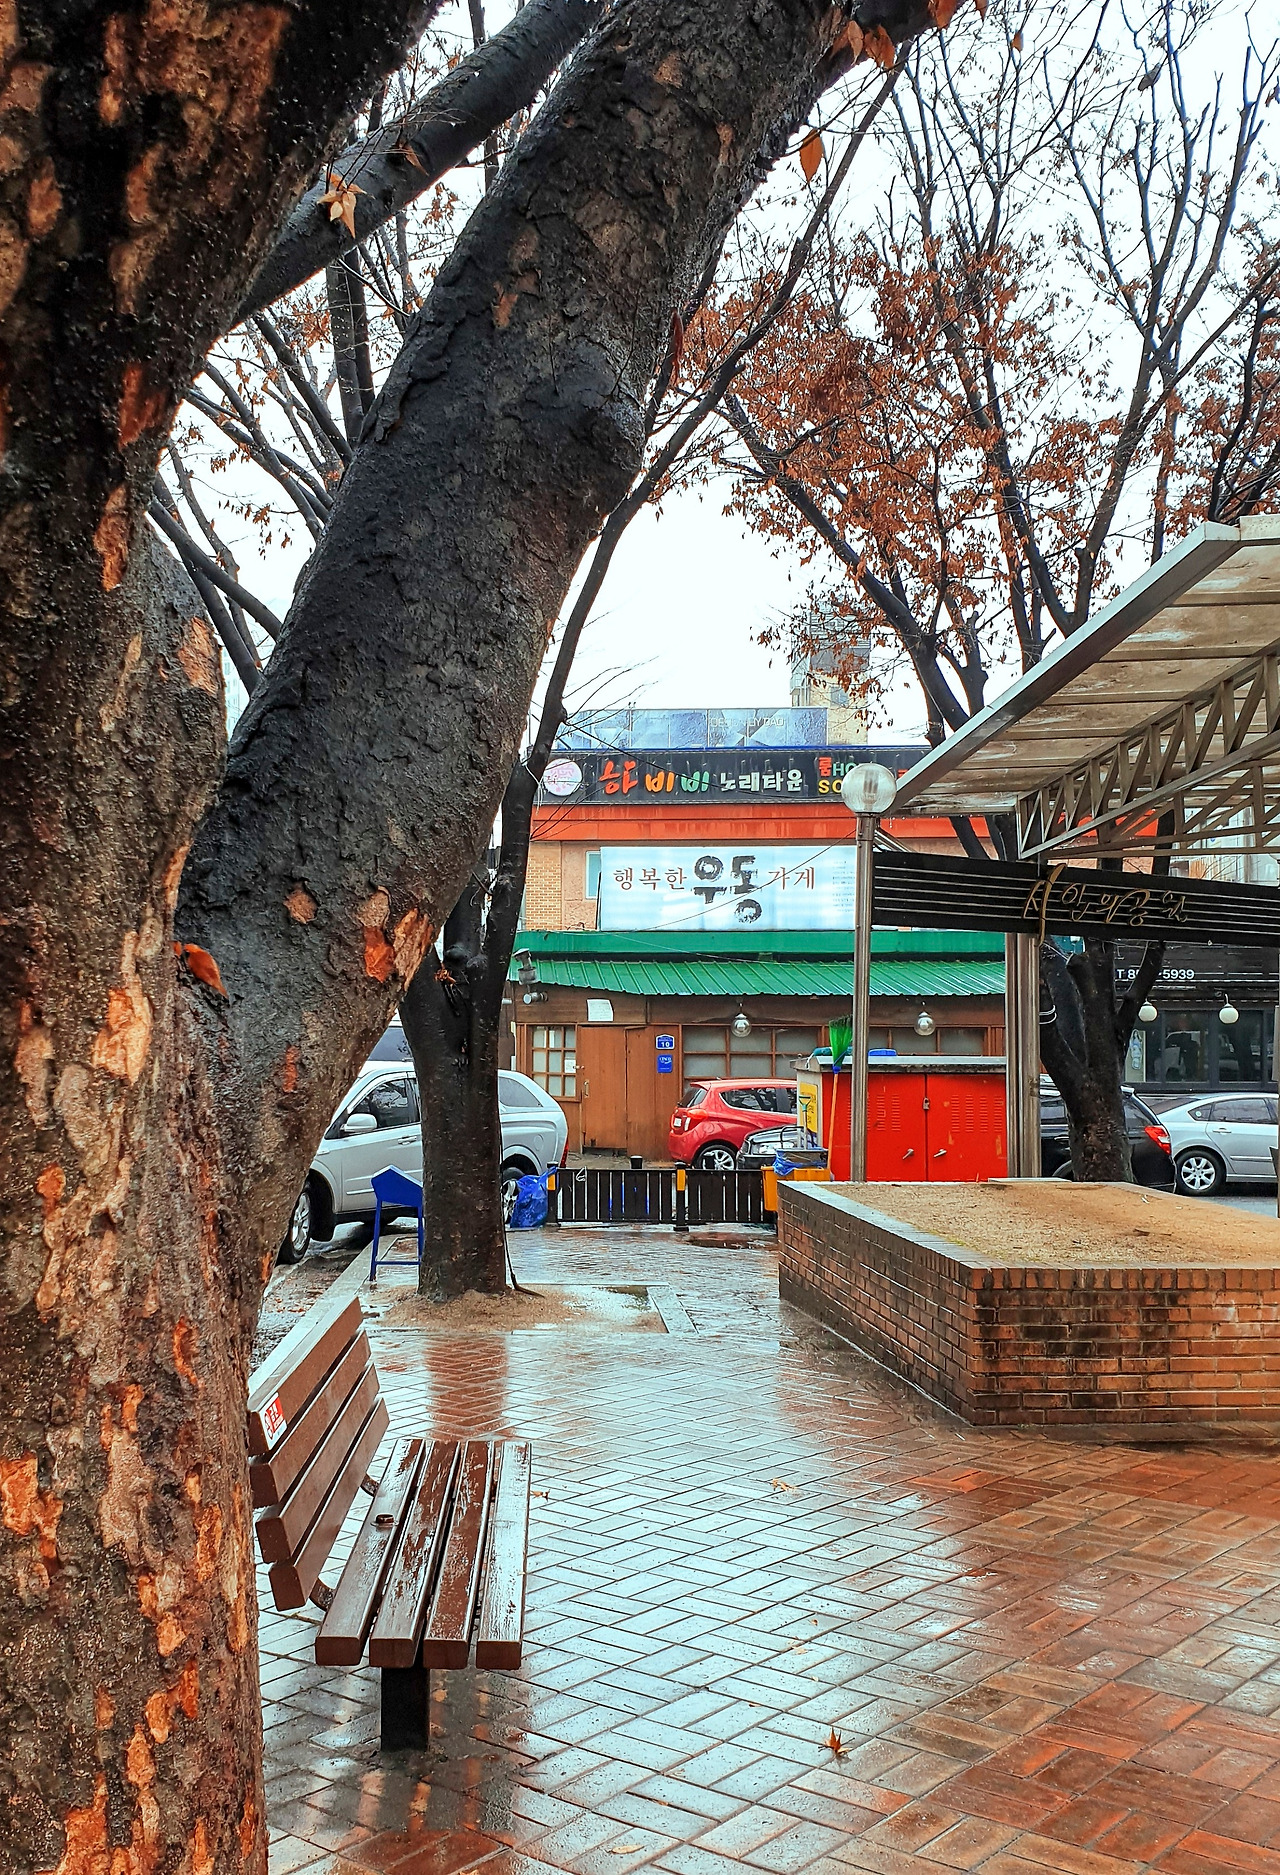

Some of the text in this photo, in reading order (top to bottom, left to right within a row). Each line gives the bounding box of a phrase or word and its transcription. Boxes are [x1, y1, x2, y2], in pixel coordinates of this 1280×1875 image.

[720, 769, 803, 792] 노래타운
[613, 866, 688, 891] 행복한
[690, 855, 763, 923] 우동
[767, 866, 816, 891] 가게
